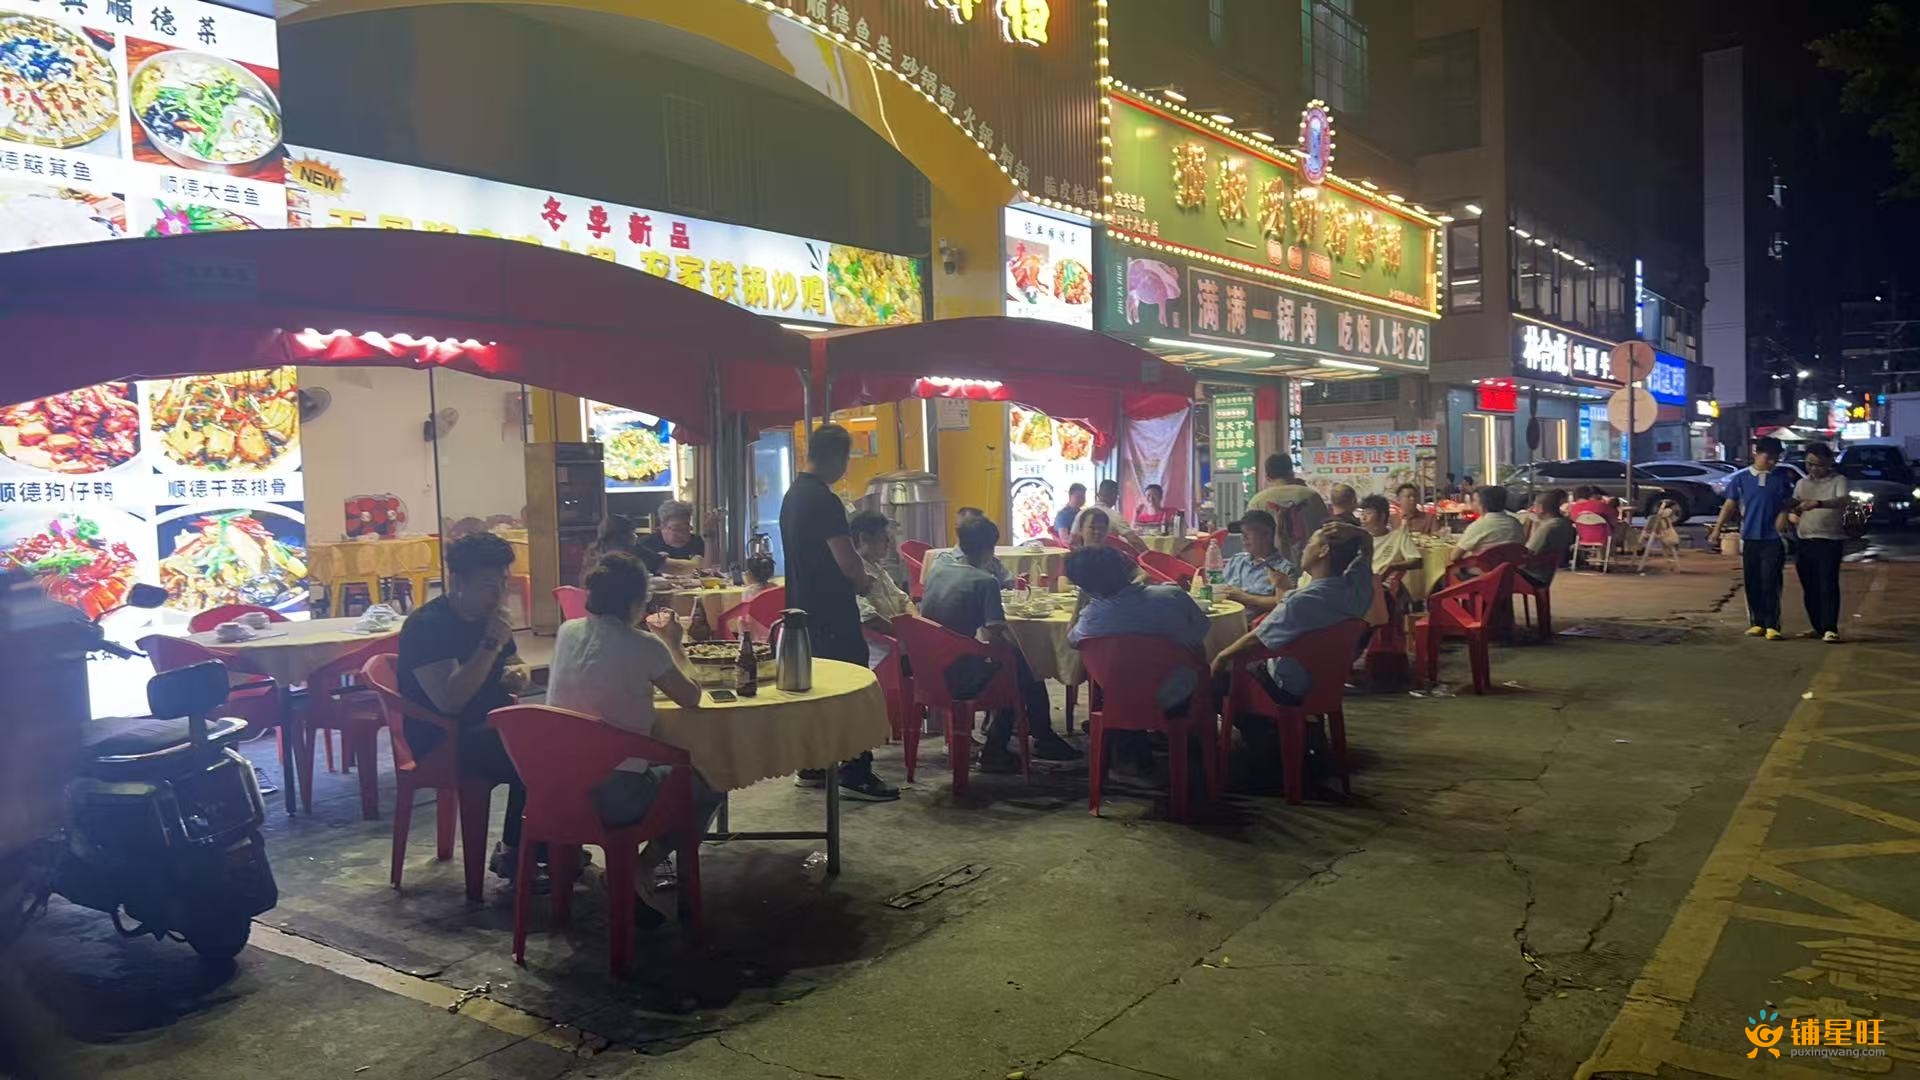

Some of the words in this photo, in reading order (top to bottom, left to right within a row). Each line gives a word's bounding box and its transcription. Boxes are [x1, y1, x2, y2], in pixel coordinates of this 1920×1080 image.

[806, 0, 892, 62] 顺德鱼生
[900, 54, 955, 108] 砂锅粥
[962, 107, 993, 149] 火锅
[300, 166, 337, 191] NEW
[541, 195, 691, 250] 冬季新品
[640, 250, 826, 316] 农家铁锅炒鸡
[1197, 278, 1318, 344] 满满一锅肉
[1337, 310, 1425, 362] 吃饱人均26
[0, 480, 114, 502] 顺德狗仔鸭
[168, 478, 287, 498] 顺德干蒸排骨
